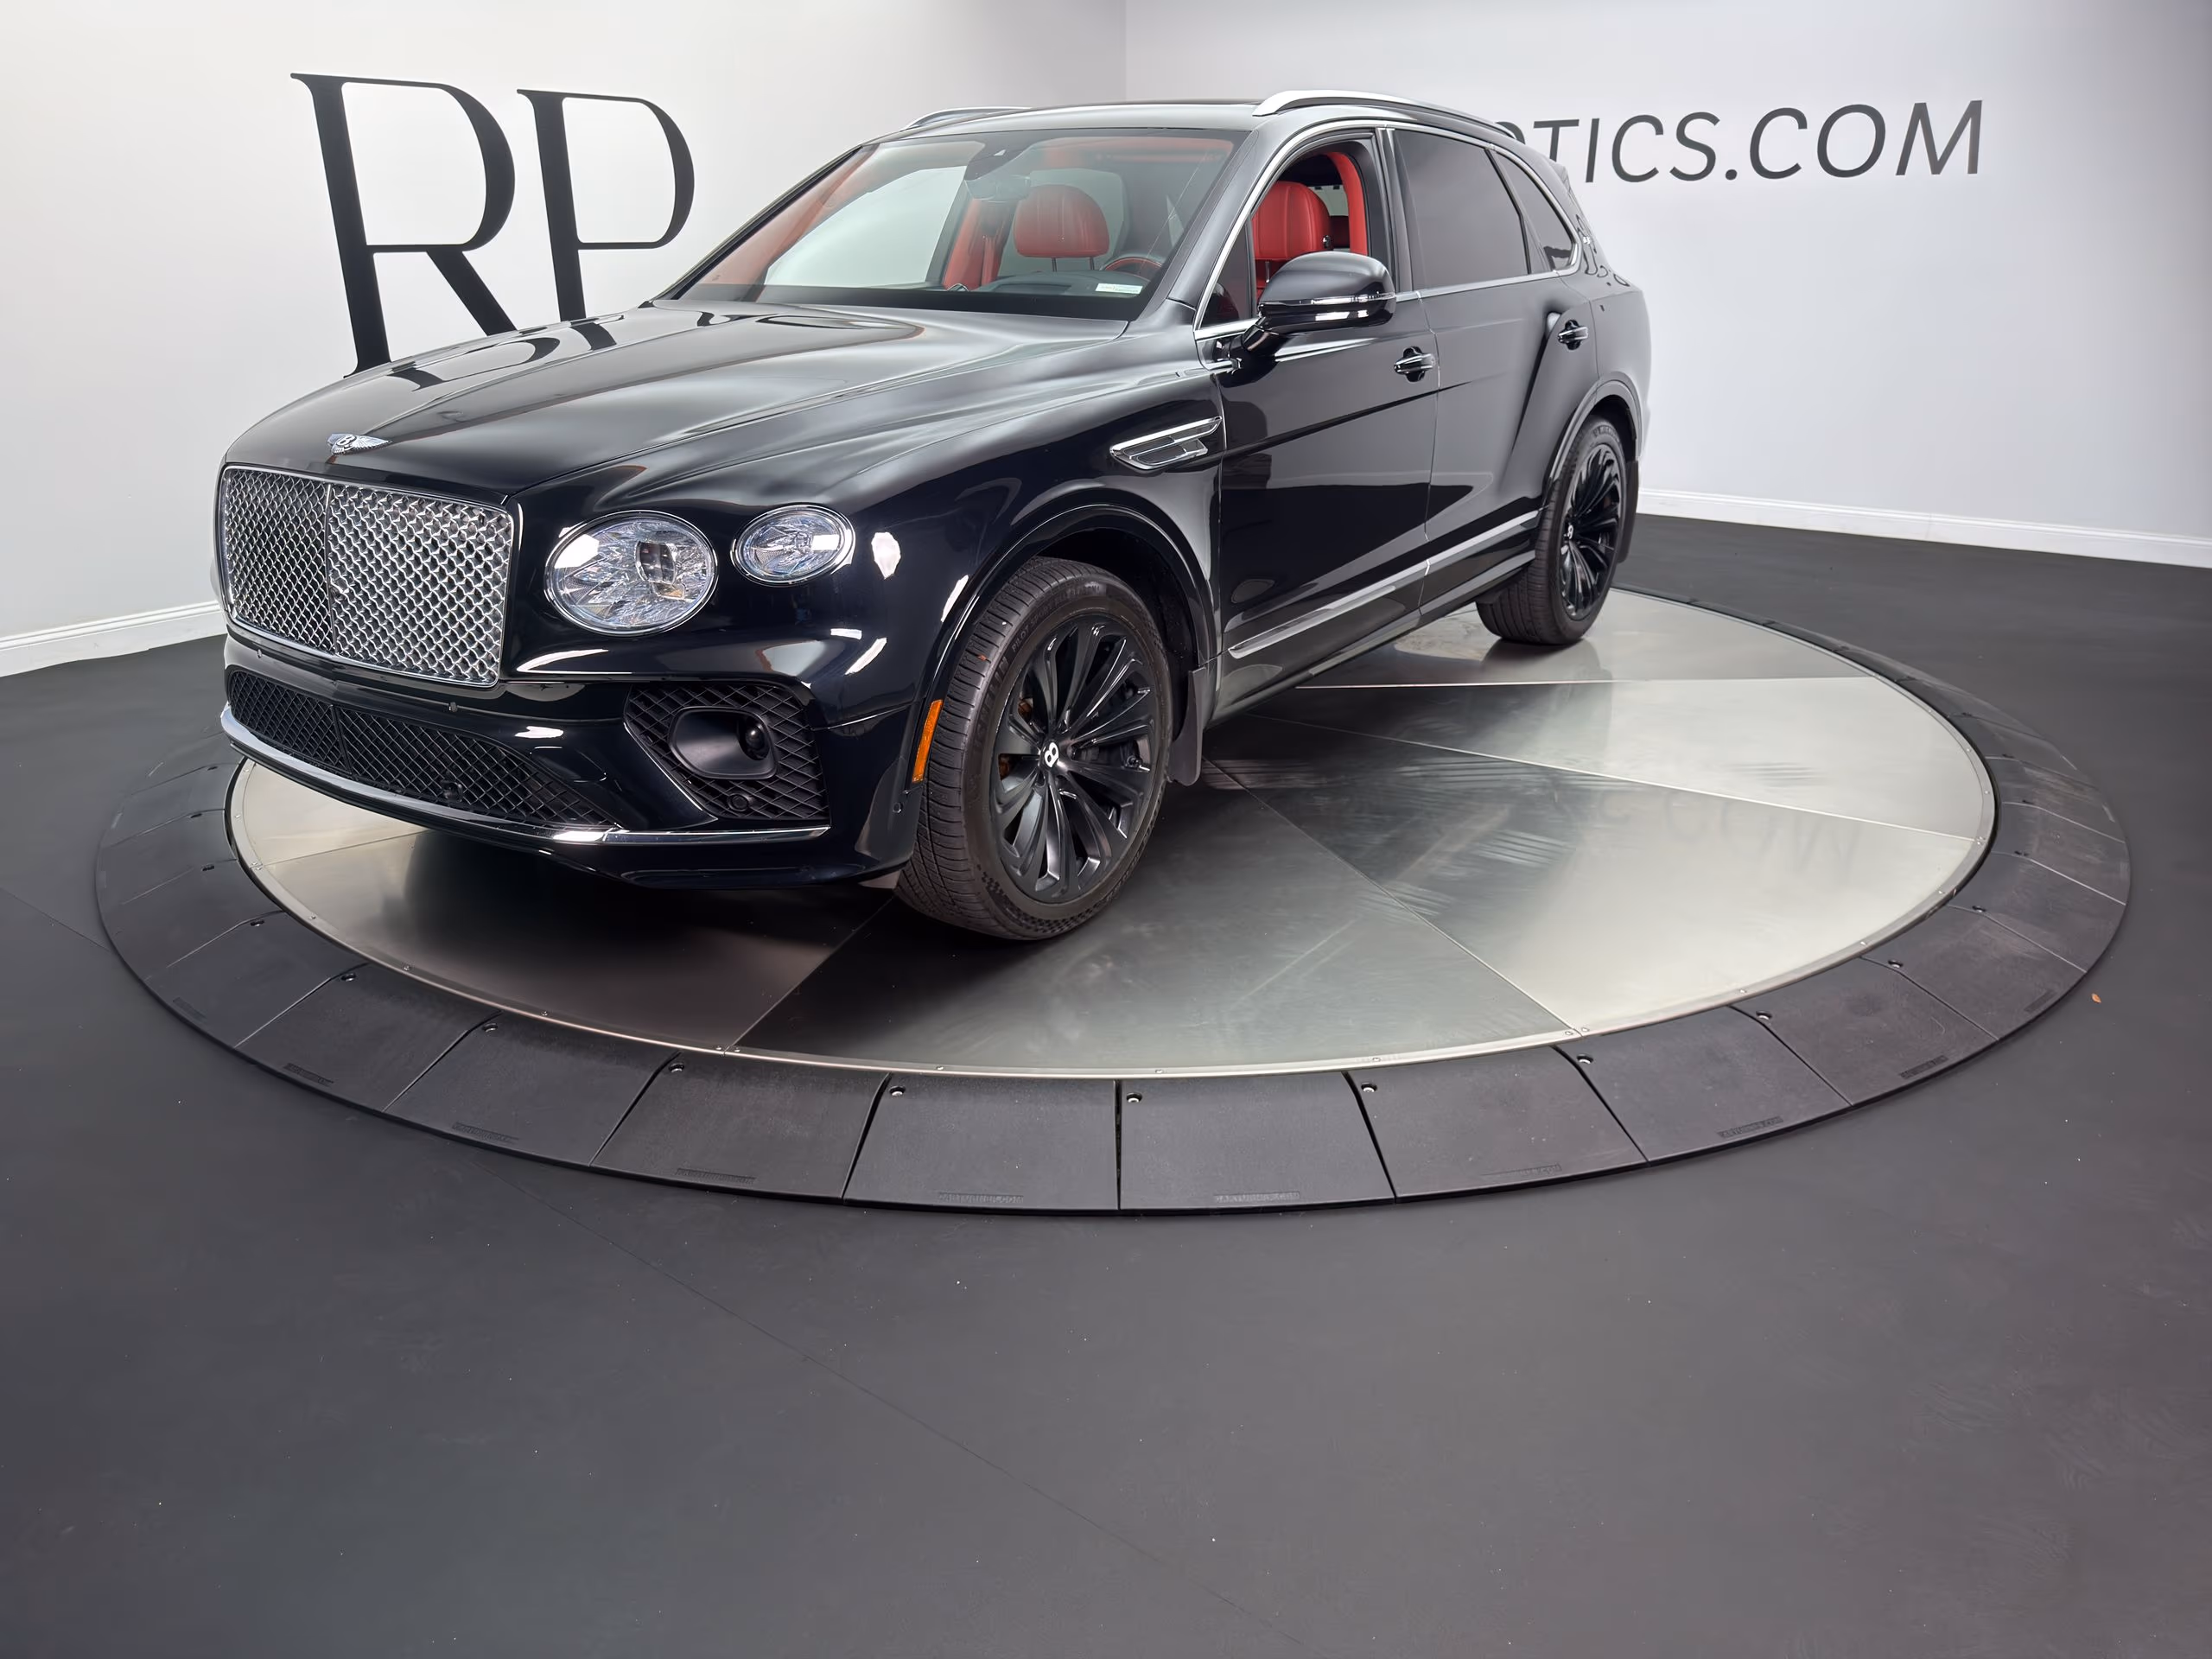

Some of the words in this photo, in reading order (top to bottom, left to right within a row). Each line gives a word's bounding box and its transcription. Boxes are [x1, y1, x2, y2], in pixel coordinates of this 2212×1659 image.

[290, 73, 695, 378] RP
[1011, 625, 1029, 652] PILOT
[1045, 742, 1058, 767] B
